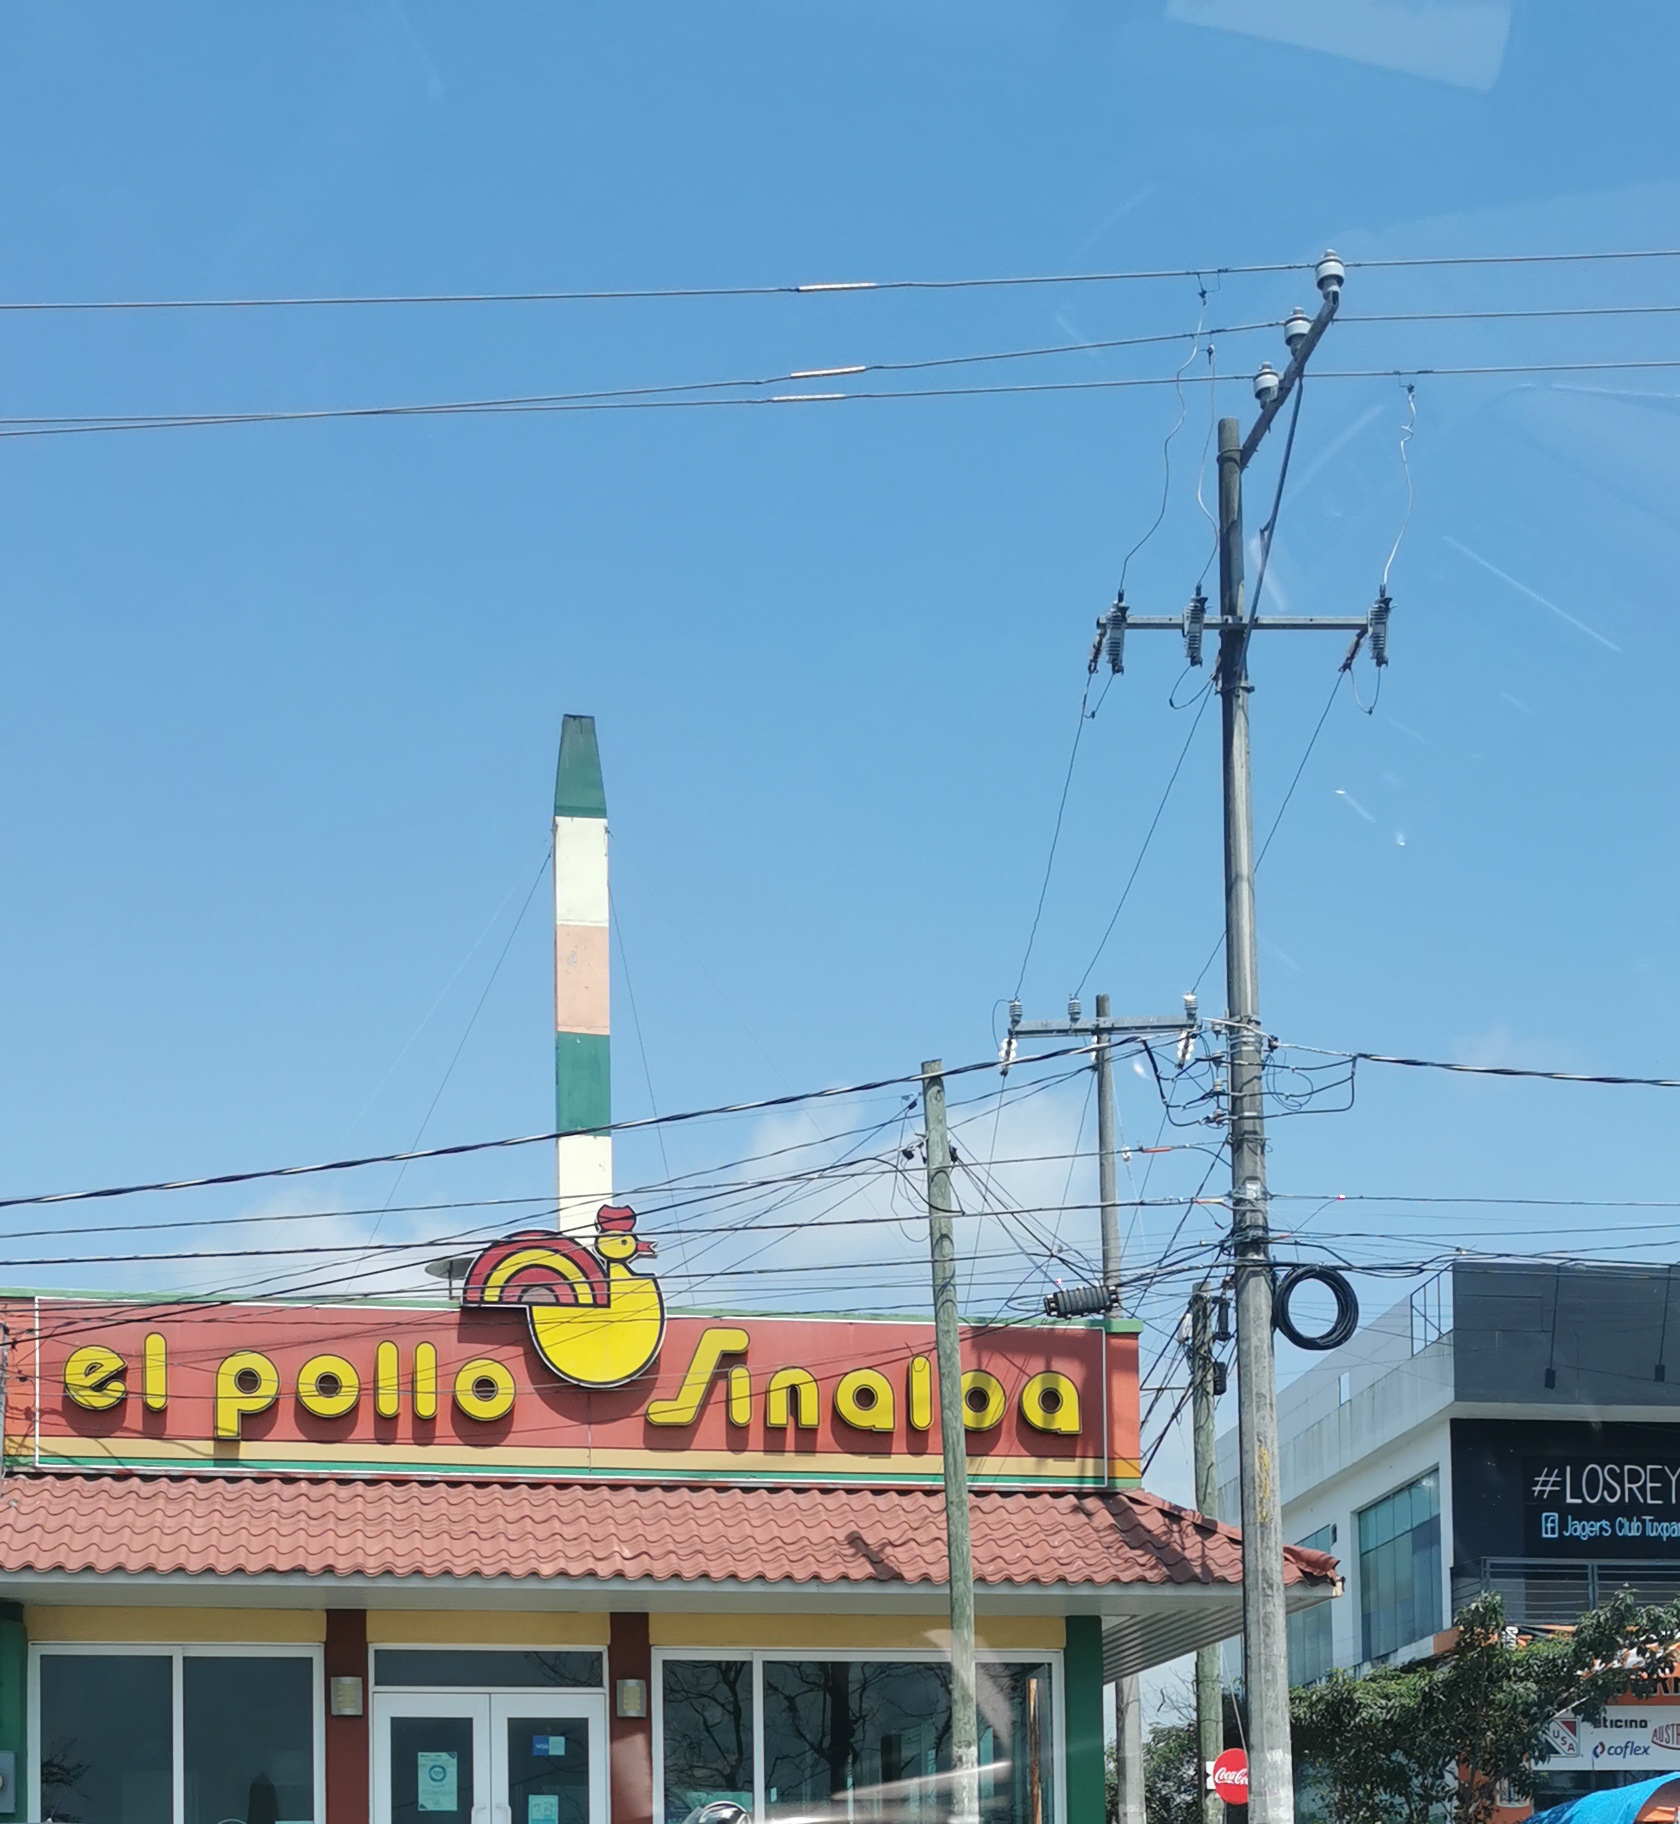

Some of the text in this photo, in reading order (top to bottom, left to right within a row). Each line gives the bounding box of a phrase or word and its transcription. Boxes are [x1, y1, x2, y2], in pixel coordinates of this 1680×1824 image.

[63, 1328, 1083, 1440] el pollo Sinaloa
[1615, 1516, 1642, 1537] Club
[1552, 1729, 1575, 1752] USA
[1607, 1740, 1650, 1759] coflex
